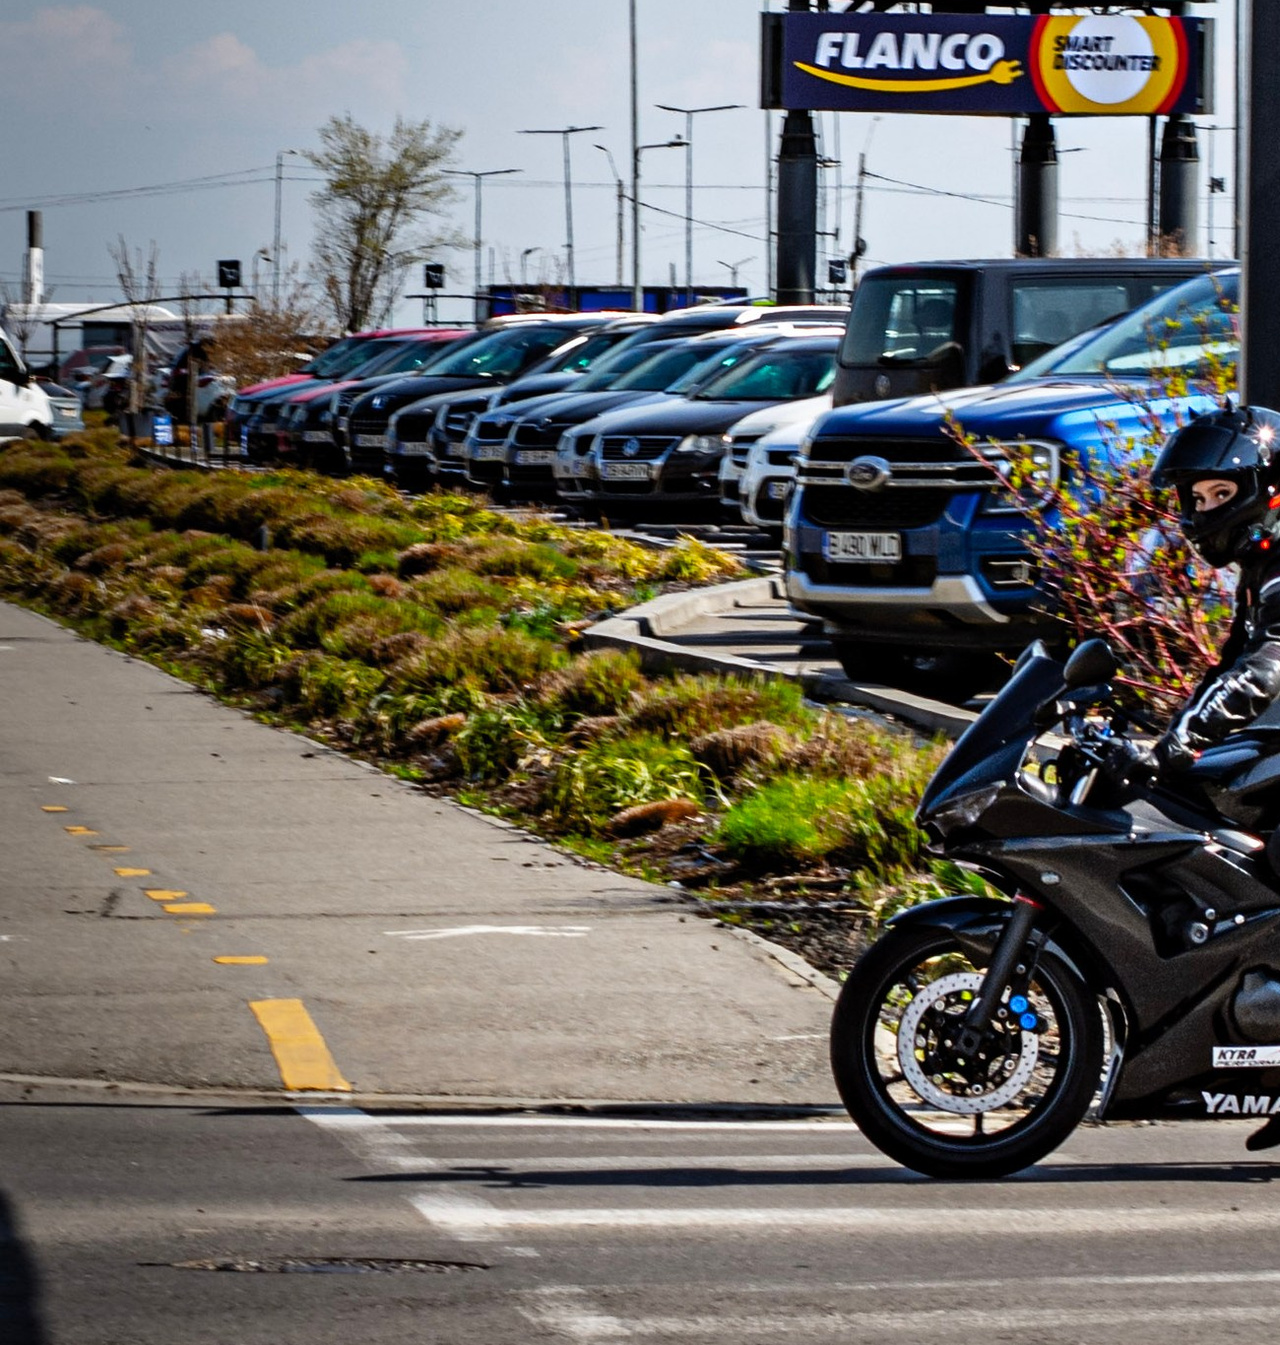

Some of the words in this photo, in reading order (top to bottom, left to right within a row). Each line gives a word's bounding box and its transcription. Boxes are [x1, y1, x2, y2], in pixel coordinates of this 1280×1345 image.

[814, 32, 1005, 71] FLANCO
[1053, 36, 1115, 53] SMART
[1053, 54, 1160, 72] DISCOUNTER
[1217, 1049, 1258, 1060] KYRA
